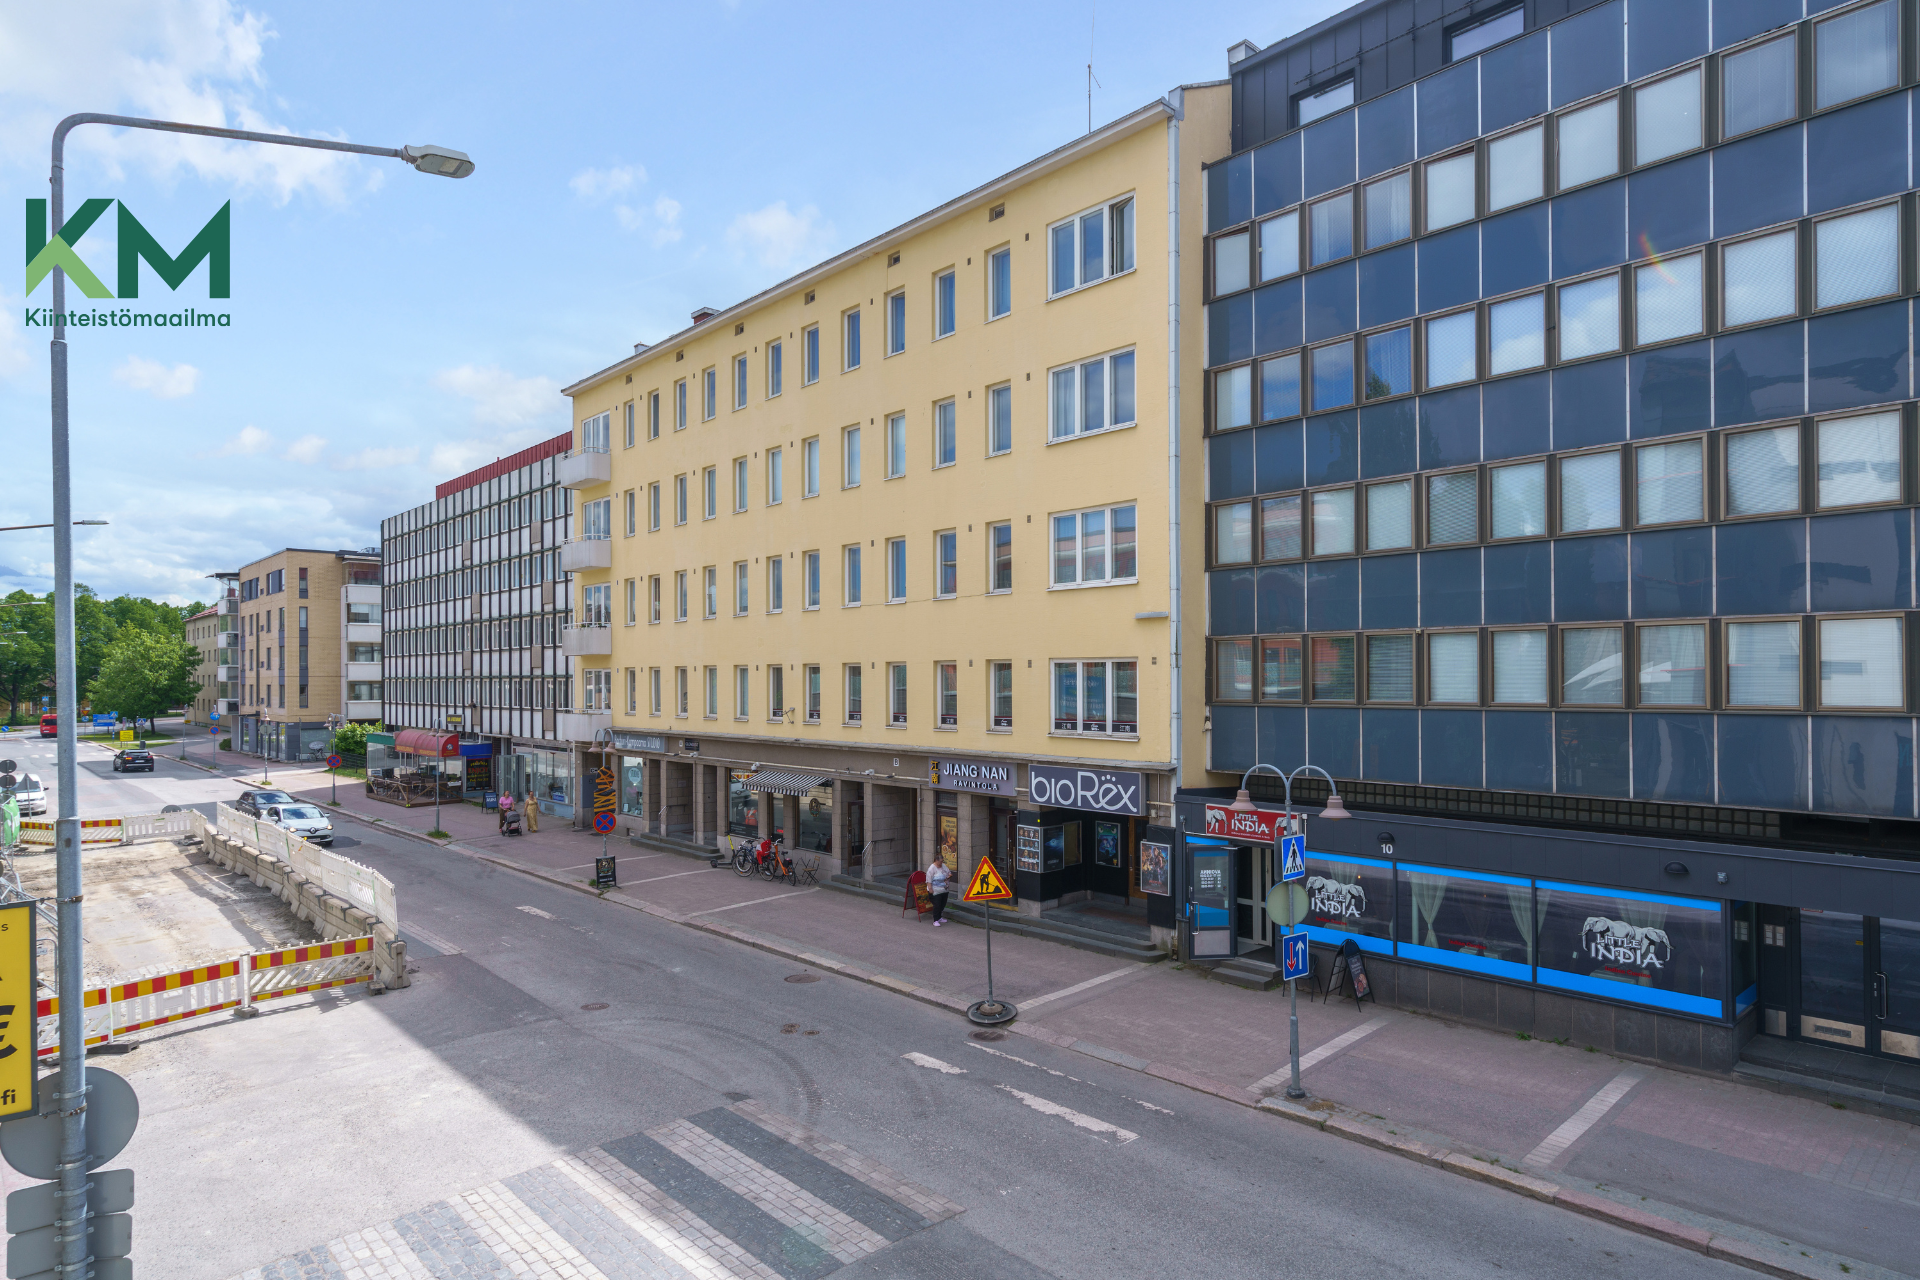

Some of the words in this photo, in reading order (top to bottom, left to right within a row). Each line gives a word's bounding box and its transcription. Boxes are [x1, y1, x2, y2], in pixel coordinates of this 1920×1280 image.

[943, 763, 978, 778] JIANG
[981, 766, 1007, 781] NAN
[953, 779, 998, 791] RAVINTOLA
[1234, 812, 1259, 822] LITTLE
[1231, 818, 1270, 834] INDIA
[1381, 843, 1393, 854] 10
[1315, 889, 1346, 901] LITTLE
[1311, 897, 1361, 918] INDIA
[1597, 933, 1640, 949] LITTLE
[1591, 942, 1664, 969] INDIA
